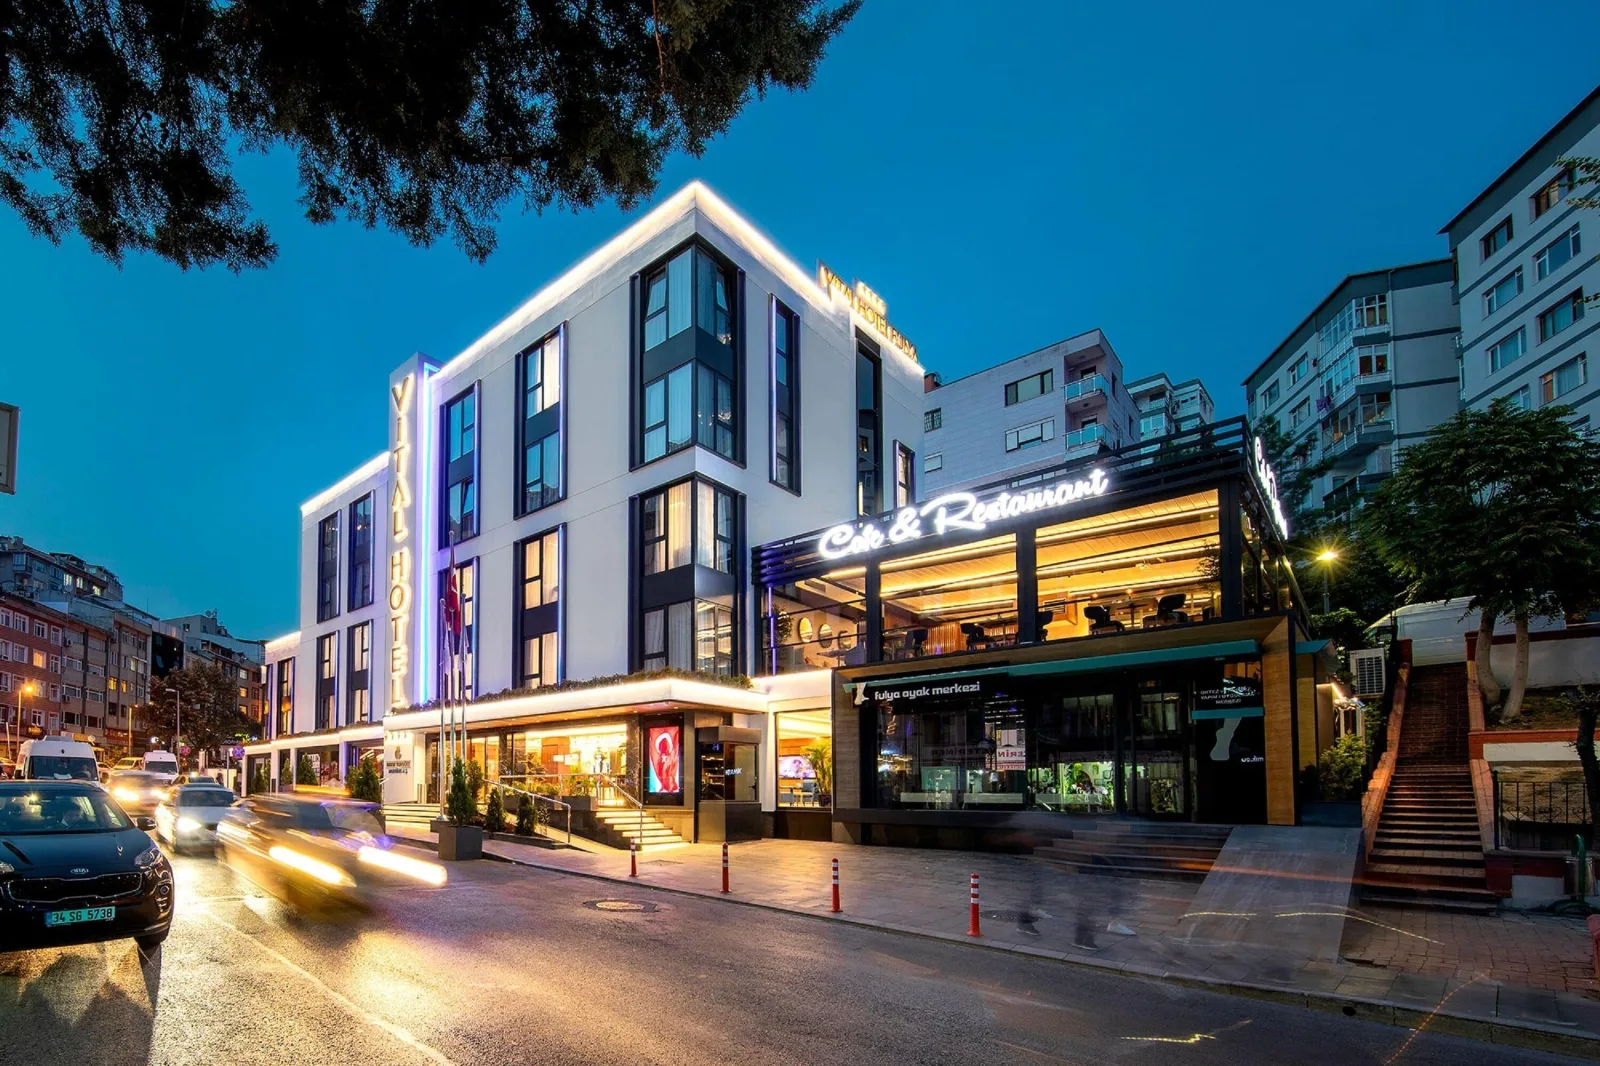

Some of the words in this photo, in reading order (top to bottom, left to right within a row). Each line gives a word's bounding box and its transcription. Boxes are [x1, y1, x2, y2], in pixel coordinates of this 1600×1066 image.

[855, 297, 888, 339] HOTEL
[888, 507, 922, 543] &
[920, 467, 1109, 531] Restaurant
[389, 550, 408, 705] HOTEL
[874, 691, 901, 702] fulya
[902, 686, 930, 700] ayak
[932, 681, 980, 696] merkezi
[52, 912, 66, 923] 34
[69, 911, 83, 921] SG
[87, 908, 113, 920] 5738
